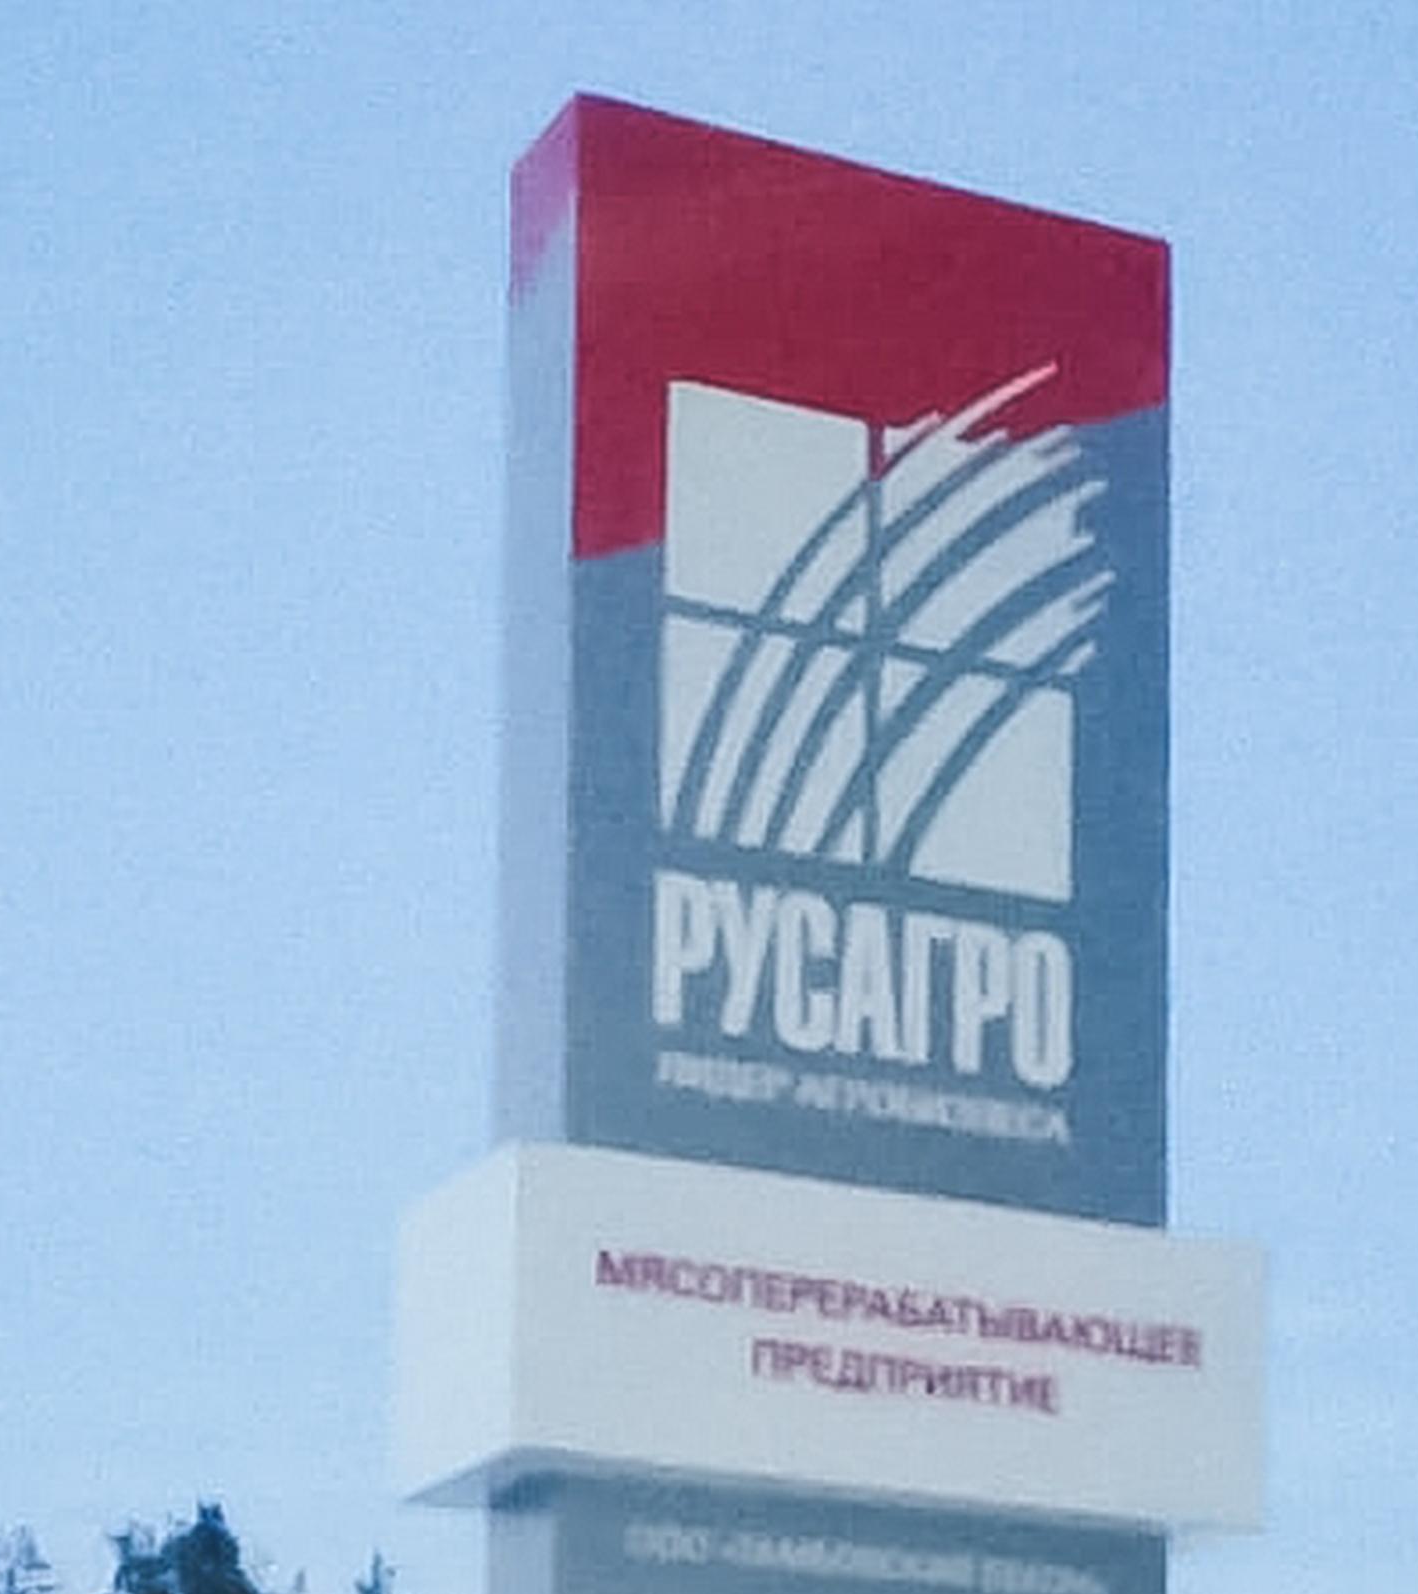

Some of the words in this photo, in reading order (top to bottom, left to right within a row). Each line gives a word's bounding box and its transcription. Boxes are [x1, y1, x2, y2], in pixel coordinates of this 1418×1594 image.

[651, 871, 1073, 1090] РУСАГРО
[595, 1250, 1203, 1367] МЯСОПЕРЕРАБАТЫВАЮЩЕЕ
[751, 1339, 1060, 1414] ПРЕДПРИЯТИЕ
